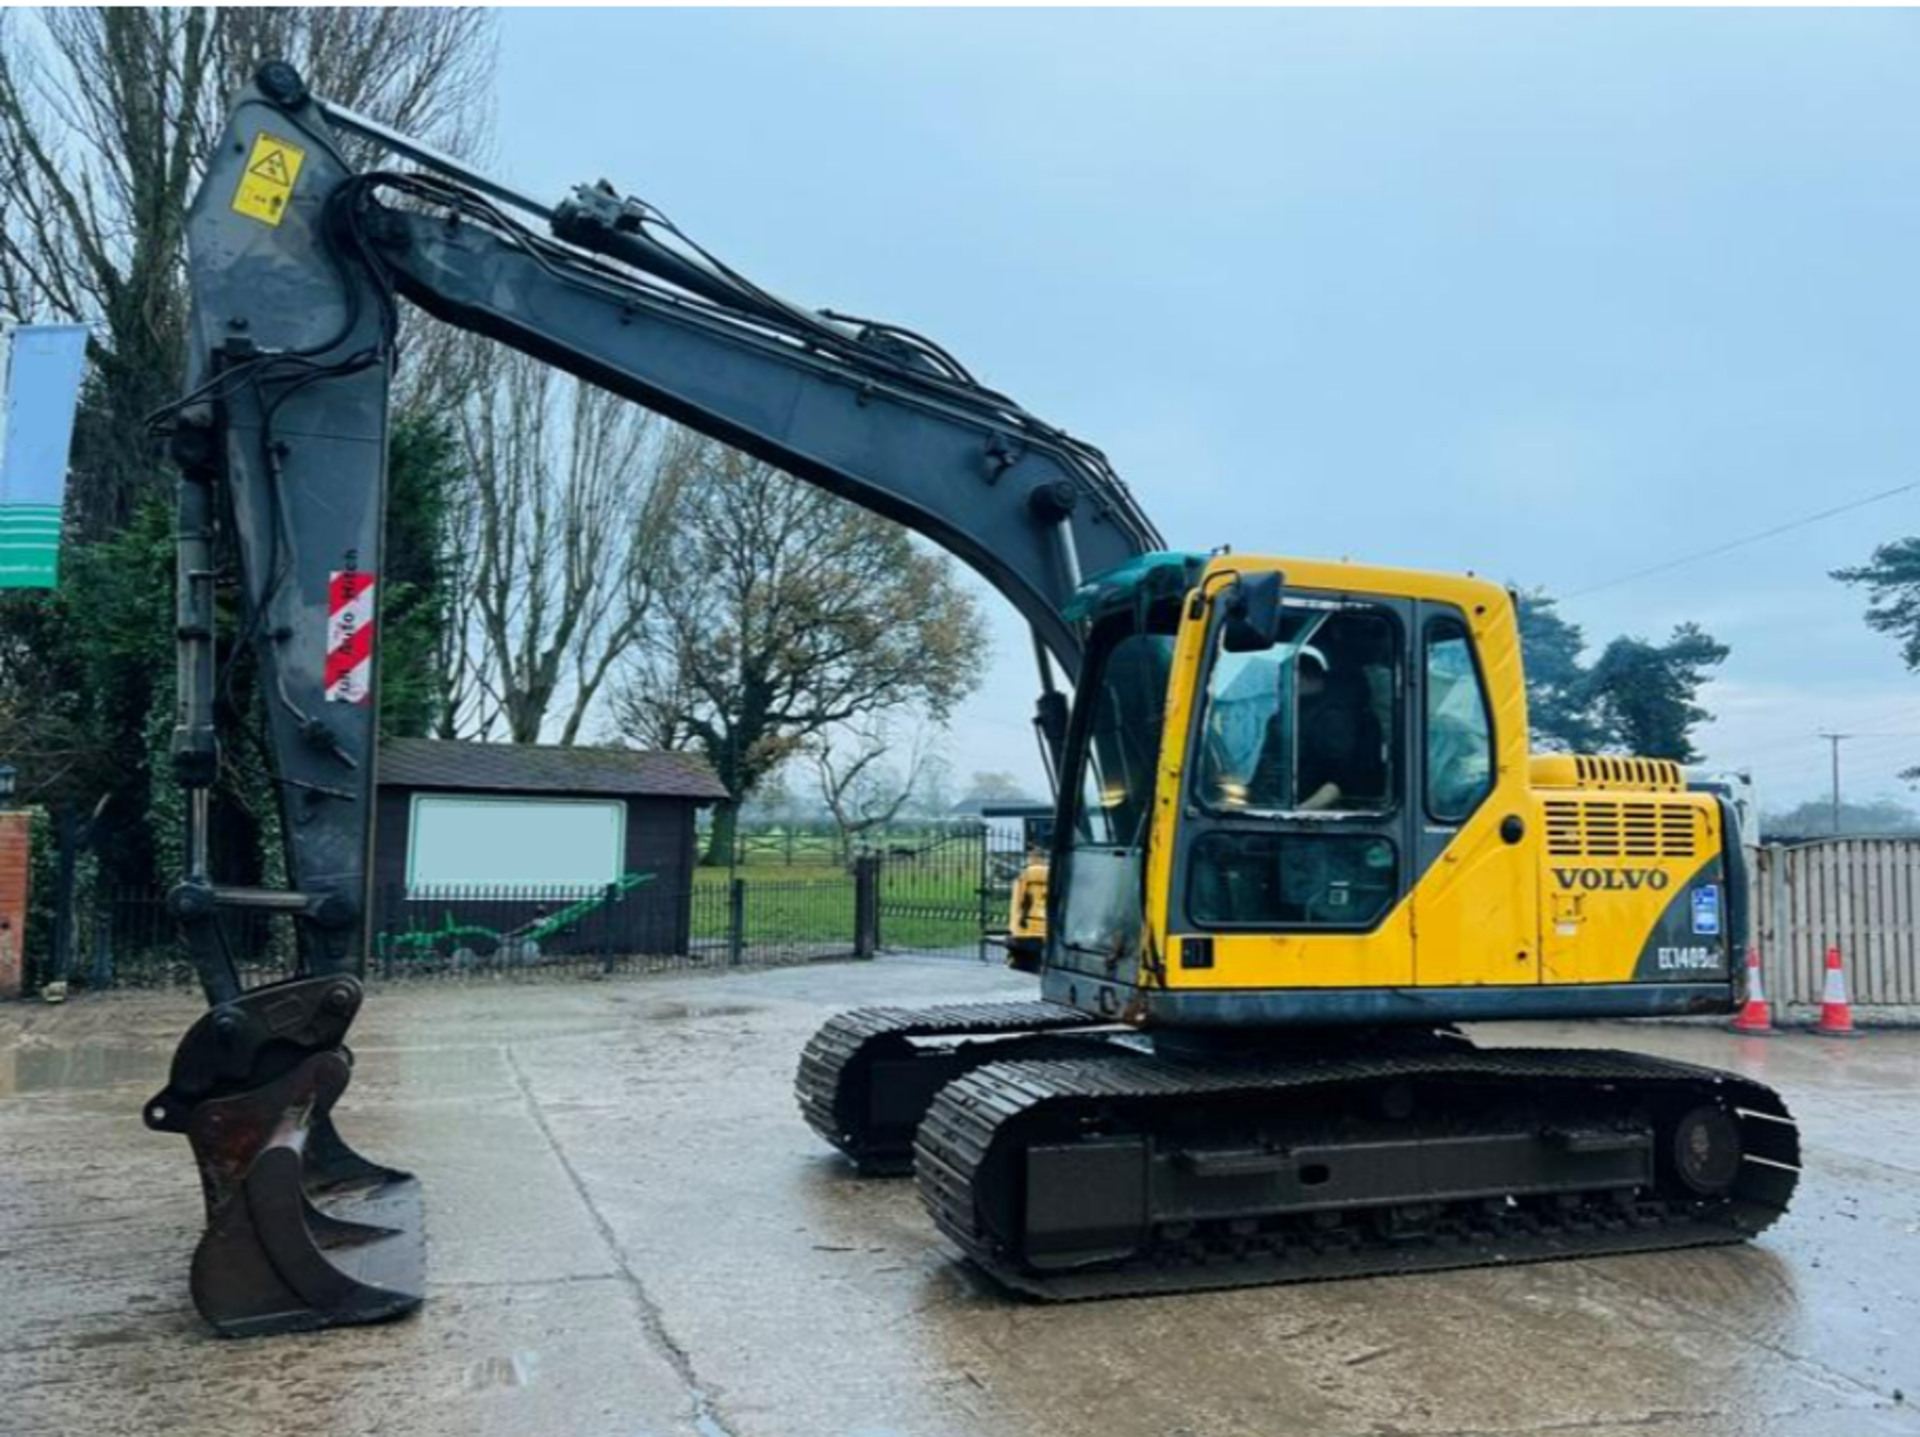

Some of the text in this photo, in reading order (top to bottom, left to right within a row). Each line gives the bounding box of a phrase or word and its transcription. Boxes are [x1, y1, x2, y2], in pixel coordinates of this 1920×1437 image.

[342, 549, 357, 598] Hitch
[338, 613, 355, 655] Auto
[1552, 868, 1669, 890] VOLVO
